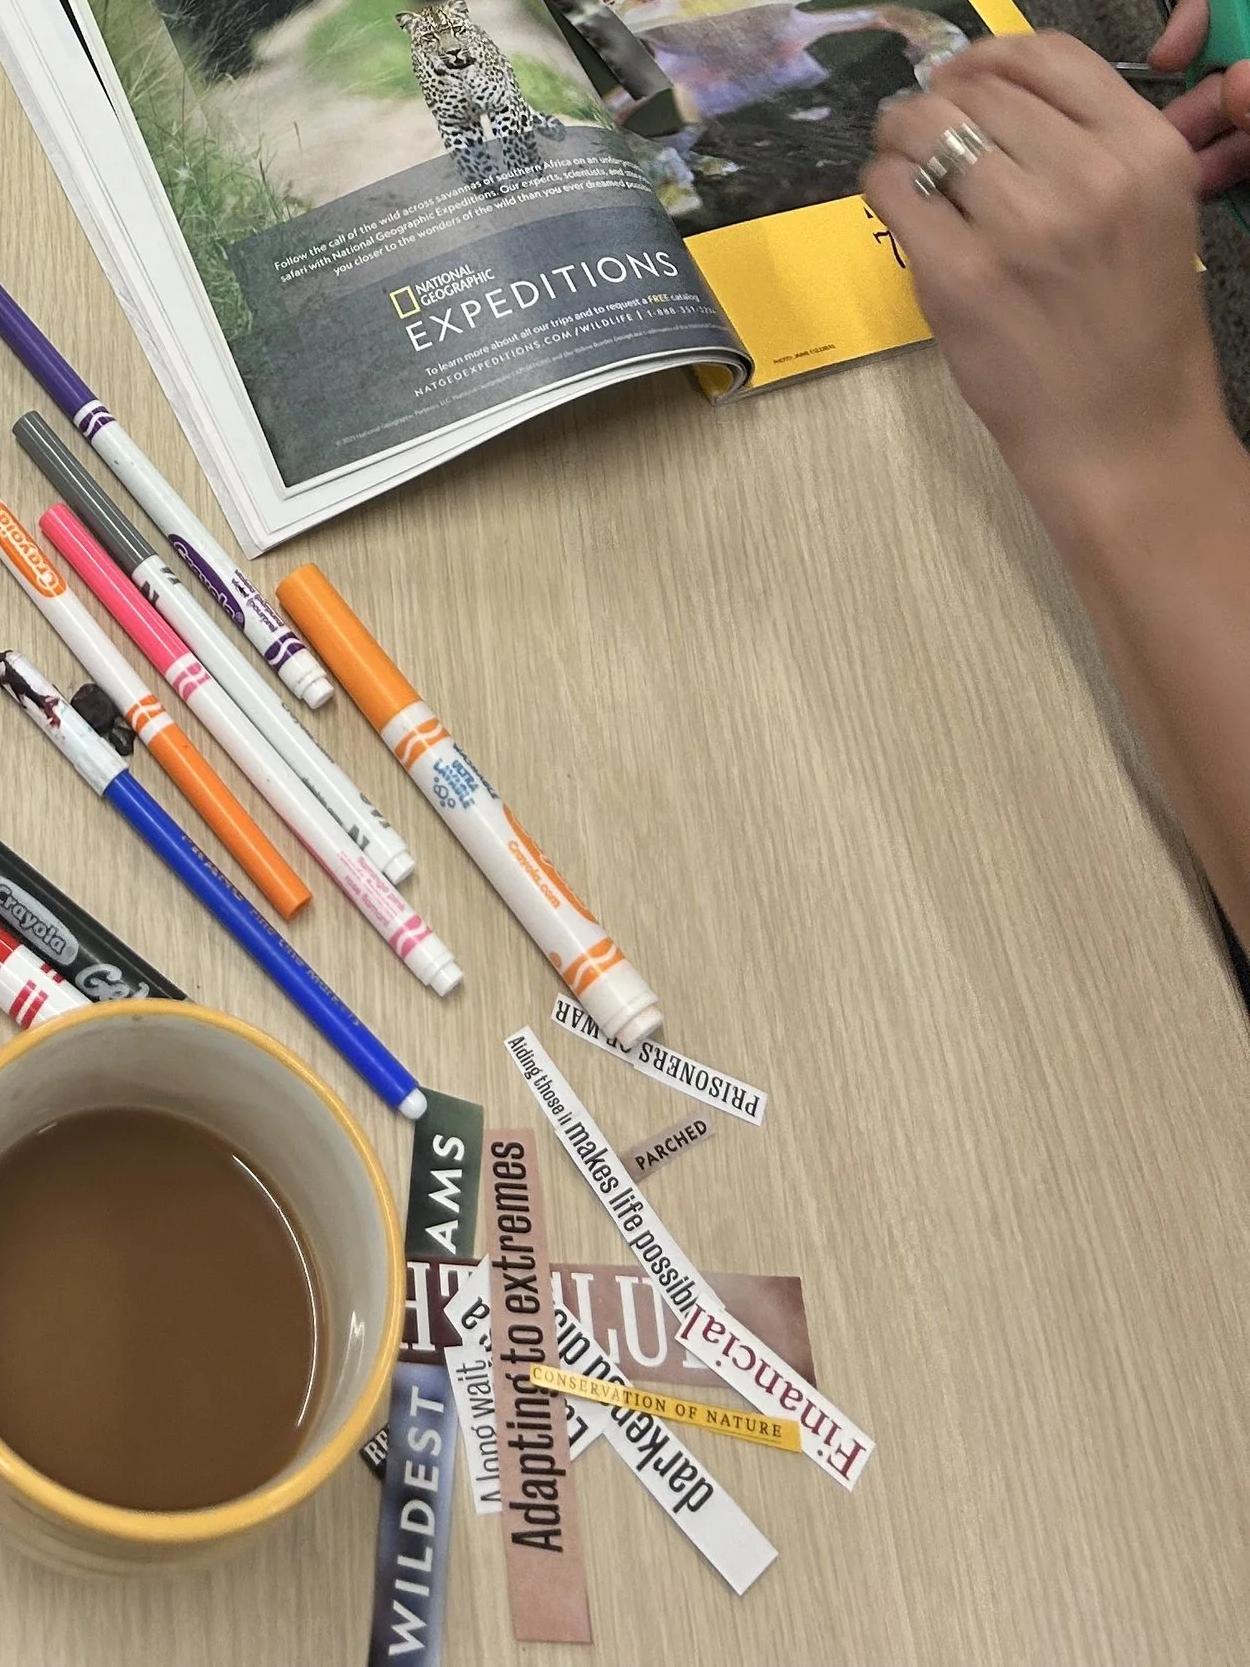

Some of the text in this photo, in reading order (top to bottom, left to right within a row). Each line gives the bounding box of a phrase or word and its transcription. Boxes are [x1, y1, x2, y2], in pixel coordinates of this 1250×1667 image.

[274, 252, 308, 271] Follow
[309, 244, 327, 256] the
[328, 234, 346, 248] call
[347, 228, 358, 240] of
[359, 222, 378, 234] the
[378, 210, 401, 225] wild
[402, 198, 435, 216] across
[435, 181, 482, 203] savannas
[483, 173, 495, 185] of
[496, 164, 542, 182] southern
[544, 159, 572, 170] Africa
[333, 262, 353, 277] you
[354, 248, 384, 266] closer
[384, 243, 397, 252] to
[398, 235, 416, 247] the
[416, 217, 462, 238] wonders
[462, 210, 473, 221] of
[474, 205, 493, 216] the
[493, 195, 517, 209] wild
[517, 191, 543, 203] than
[542, 186, 562, 198] you
[562, 182, 584, 192] ever
[405, 252, 678, 352] EXPEDITIONS
[415, 264, 475, 295] NATIONAL
[420, 268, 495, 306] GEOGRAPHIC
[425, 368, 438, 376] To
[438, 357, 464, 372] learn
[464, 346, 490, 361] more
[490, 333, 520, 350] about
[520, 327, 533, 339] all
[533, 323, 549, 334] our
[550, 316, 574, 328] trips
[574, 308, 593, 320] and
[593, 306, 605, 315] to
[606, 298, 641, 311] request
[647, 294, 670, 304] FREE
[575, 314, 633, 337] /WILDLIFE
[507, 840, 561, 909] Crayola.com
[508, 1035, 564, 1115] Aiding those
[638, 1042, 761, 1118] PRISONERS
[634, 1120, 708, 1170] PARCHED
[425, 1134, 466, 1255] AMS
[565, 1120, 698, 1317] makes life possibl
[490, 1140, 566, 1554] Adapting to extremes
[456, 1359, 495, 1418] wait
[532, 1365, 783, 1438] CONSERVATION OF NATURE
[681, 1302, 867, 1482] Financial
[387, 1385, 446, 1657] WILDEST
